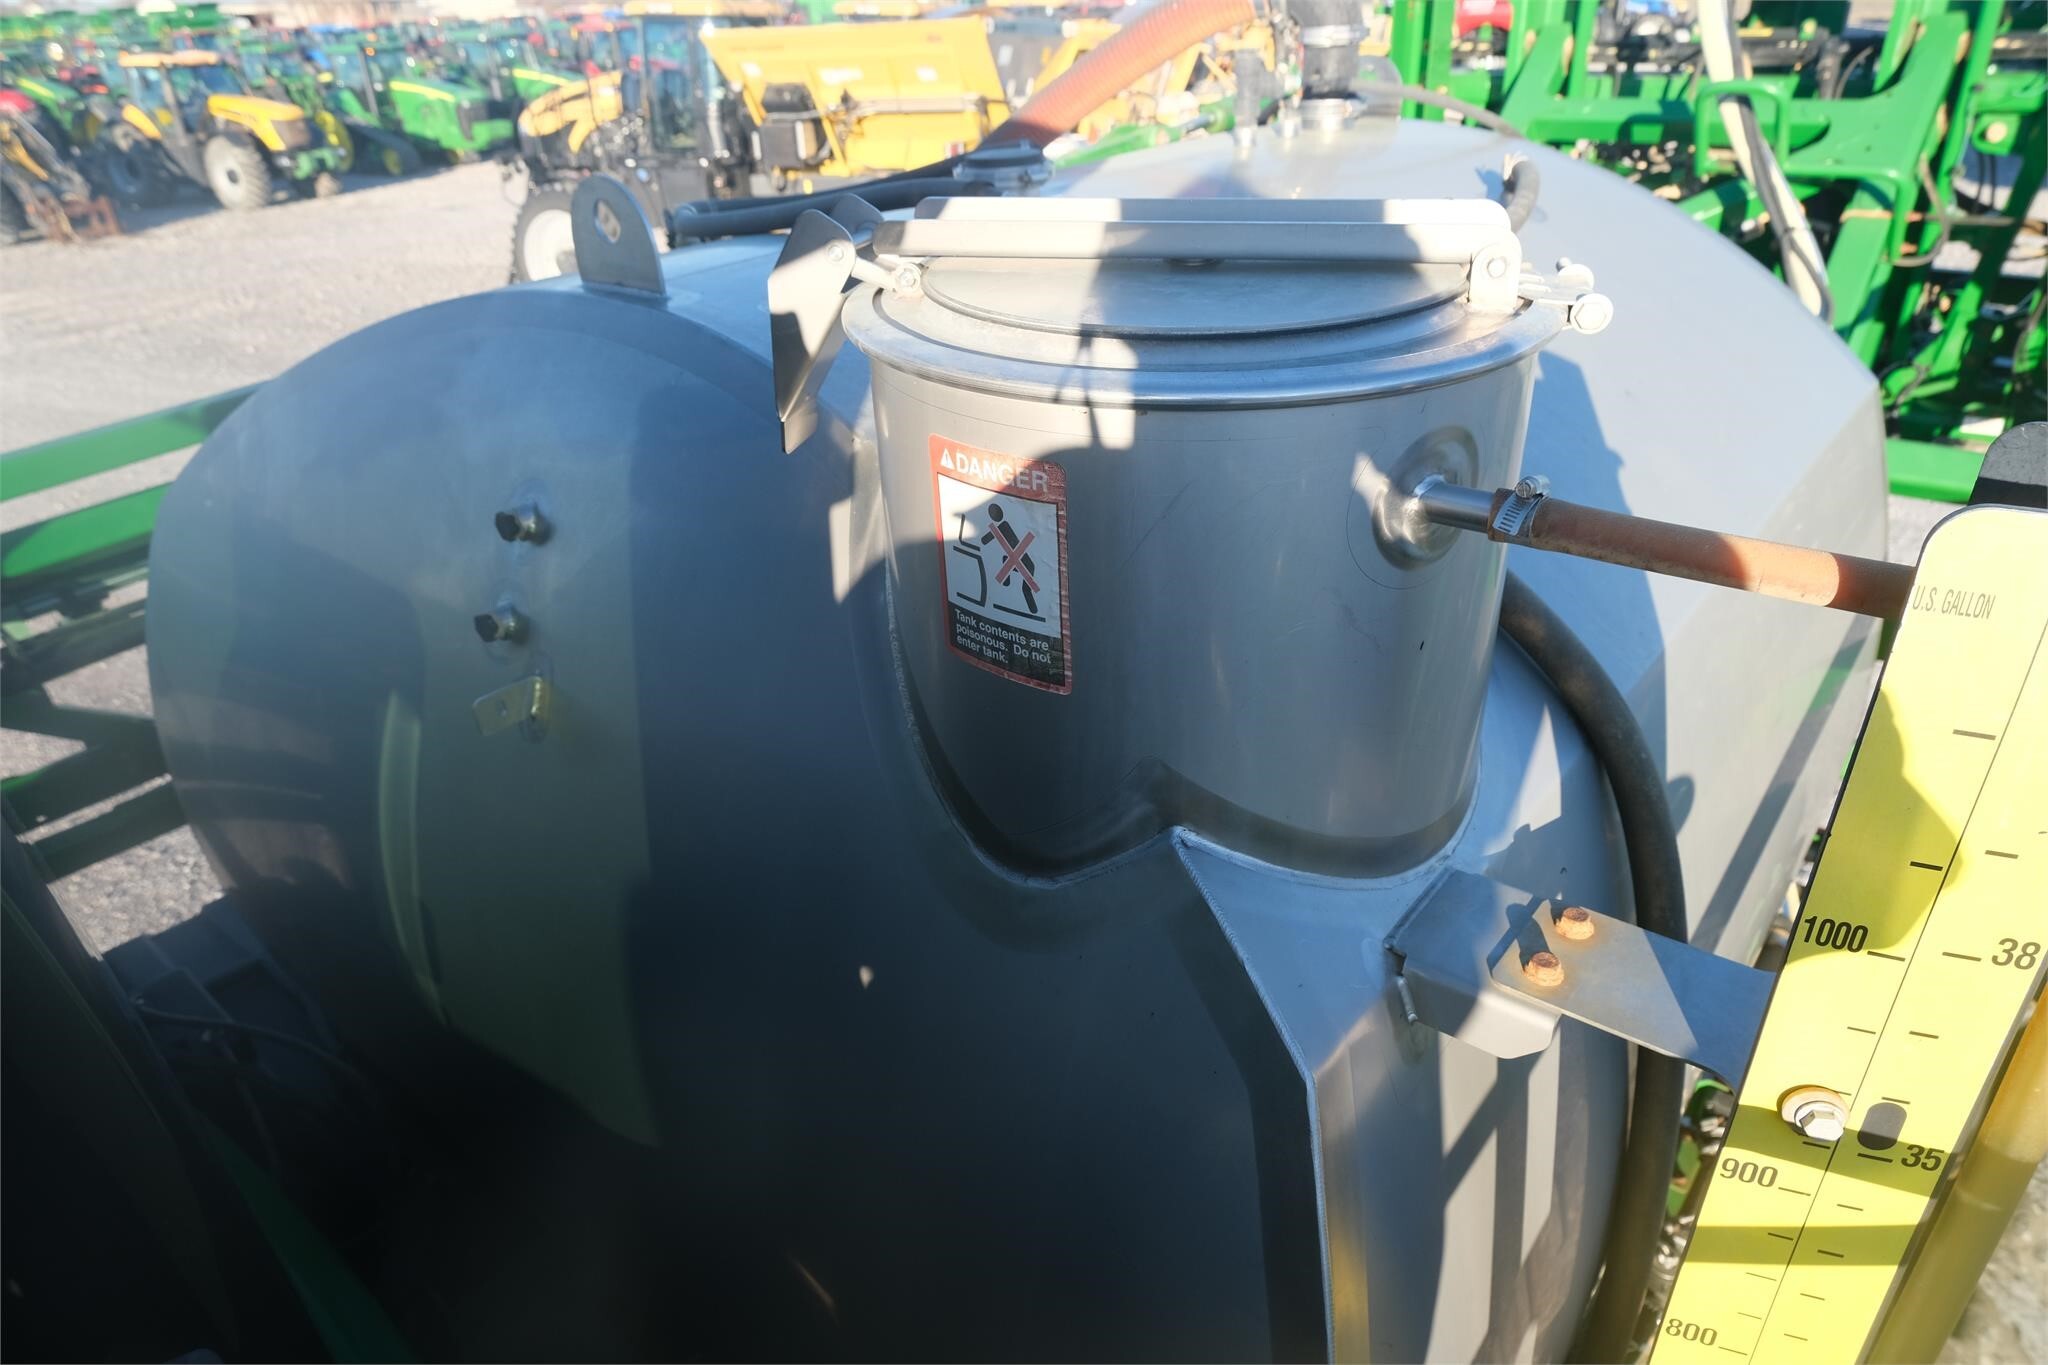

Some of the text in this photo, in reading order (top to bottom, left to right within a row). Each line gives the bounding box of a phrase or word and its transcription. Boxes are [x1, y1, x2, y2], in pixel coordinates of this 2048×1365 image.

[955, 452, 1048, 493] DANGER
[1912, 585, 1996, 620] U.S. GALLON
[954, 608, 1049, 651] Tank contents are
[956, 624, 1052, 664] poisonous. Do not
[956, 636, 1008, 664] enter tank.
[1803, 915, 1869, 953] 1000
[1991, 937, 2041, 970] 38
[1720, 1157, 1779, 1188] 900
[1901, 1144, 1945, 1171] 35
[1665, 1318, 1718, 1346] 800
